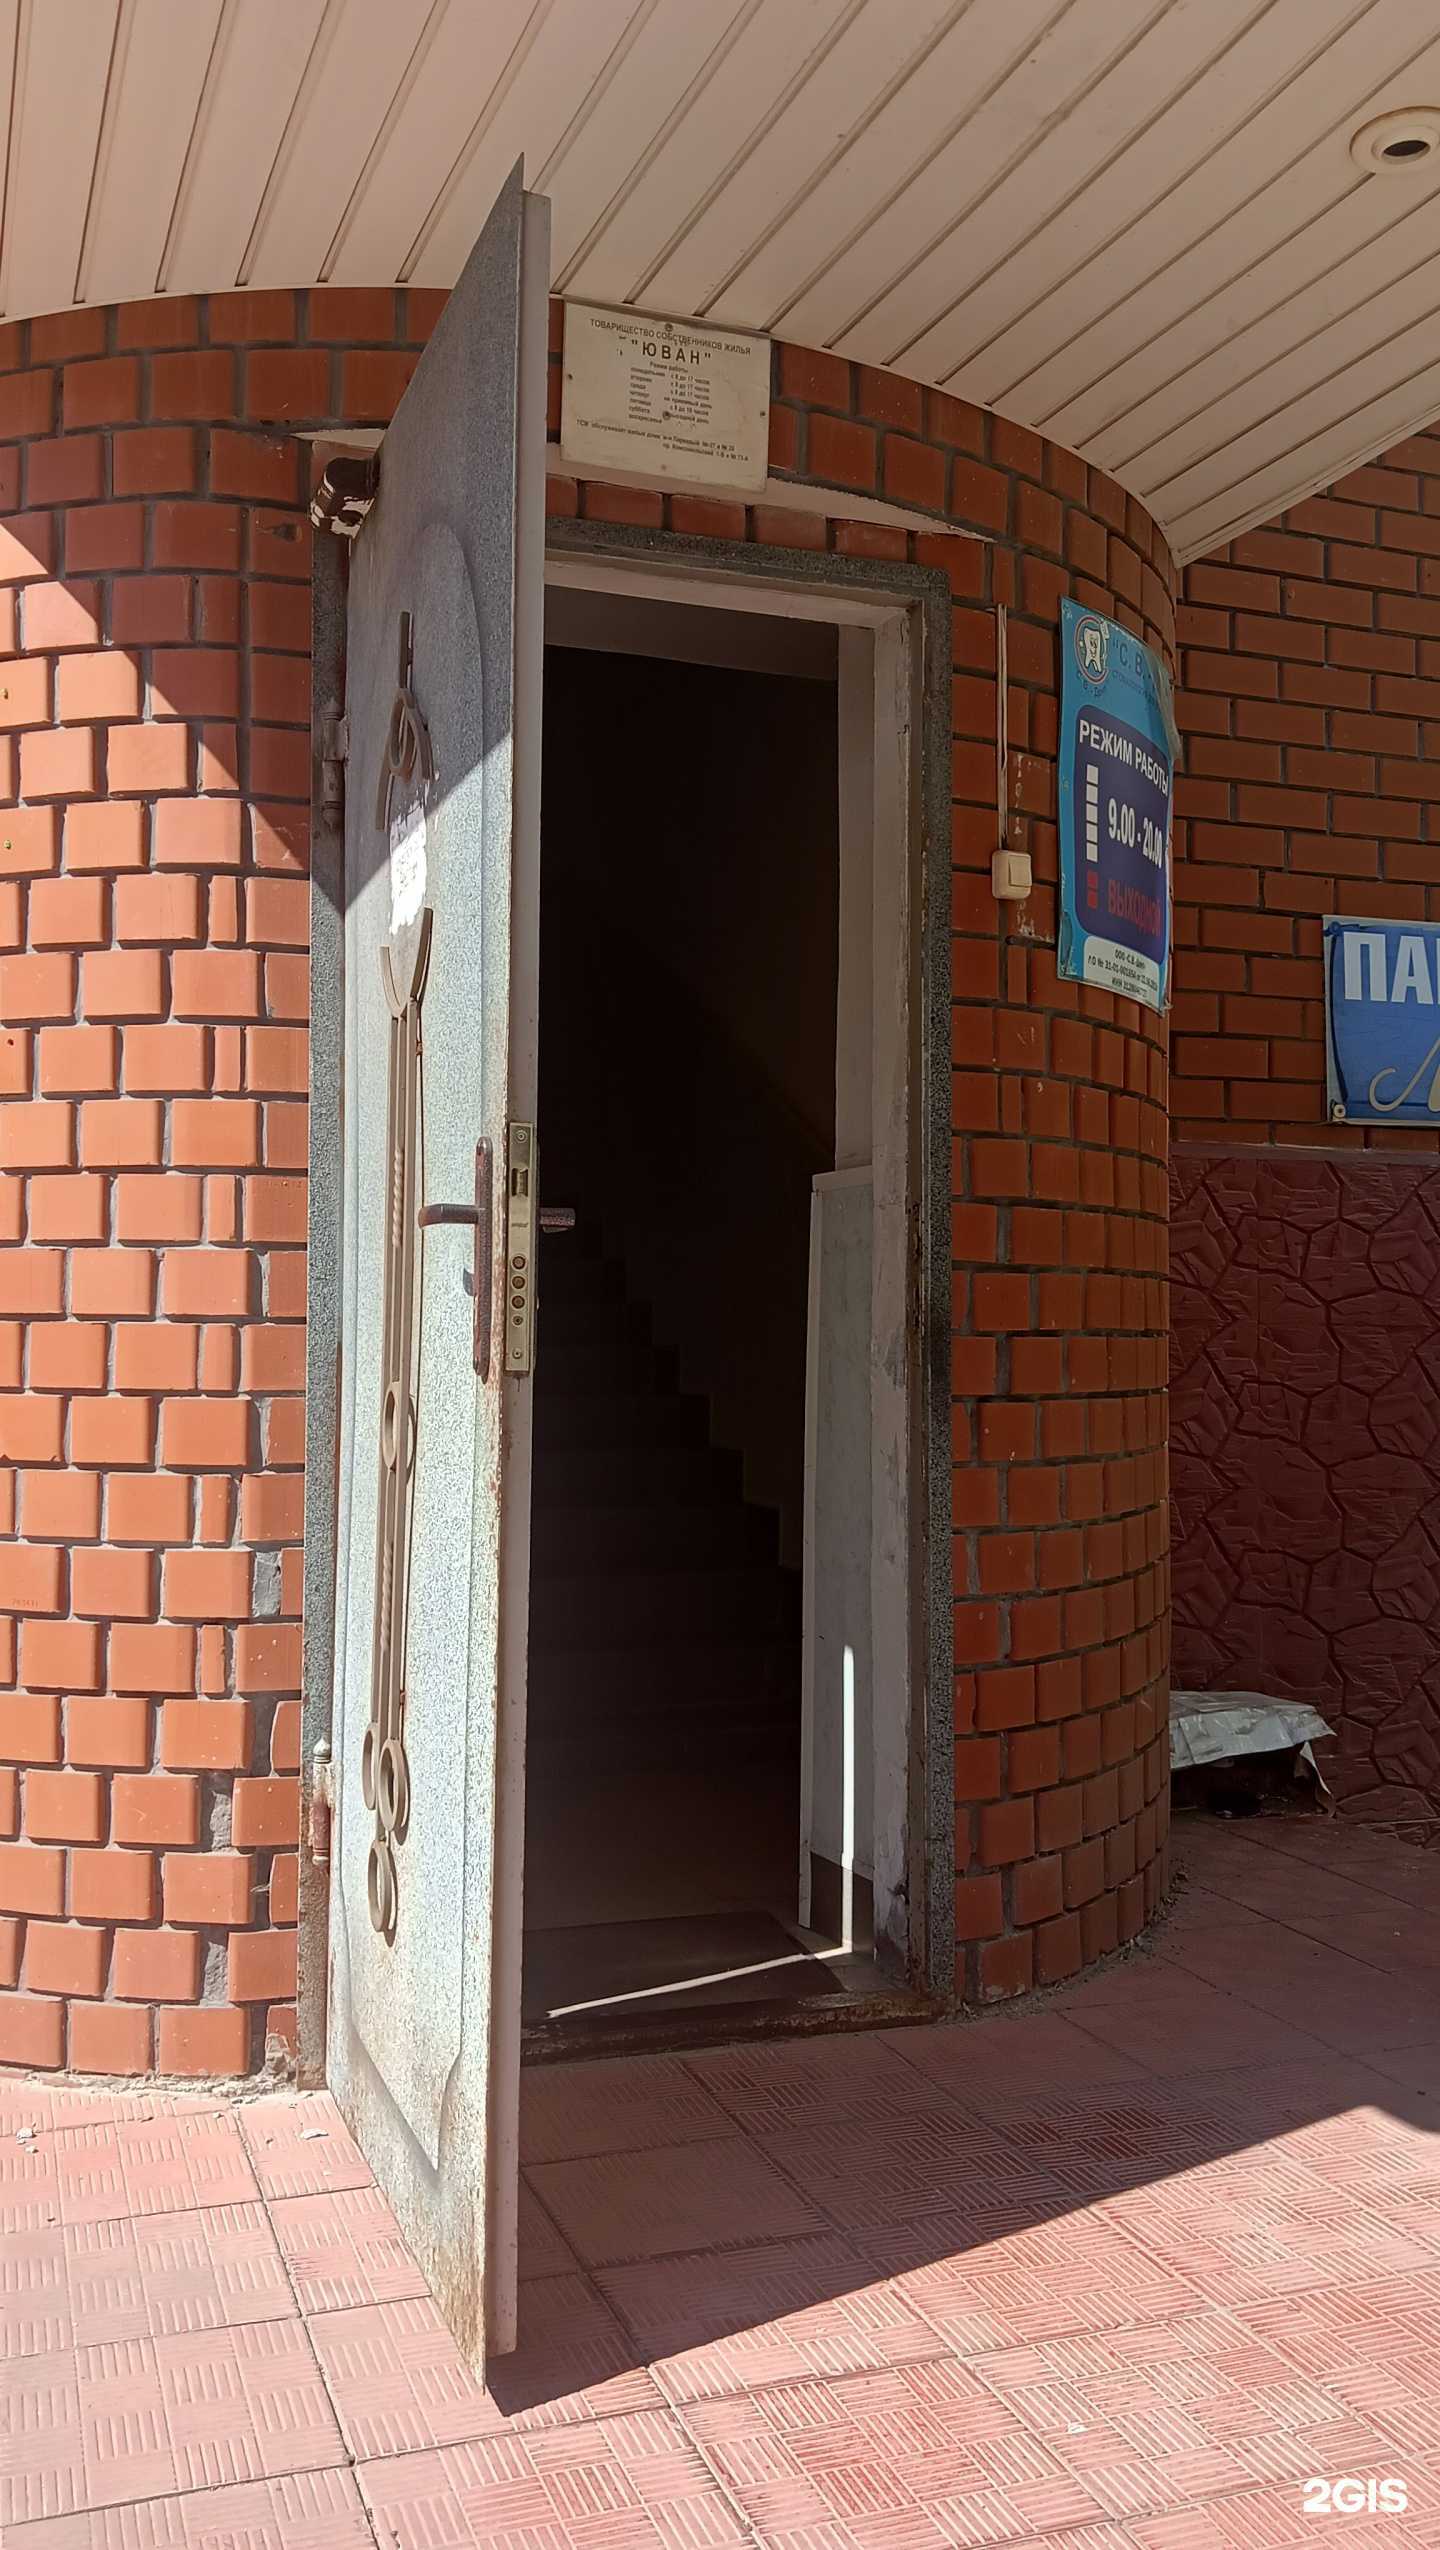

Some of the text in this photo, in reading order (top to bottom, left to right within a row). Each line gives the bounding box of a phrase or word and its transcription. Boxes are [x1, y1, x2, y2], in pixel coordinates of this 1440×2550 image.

[590, 318, 751, 355] ТОВАРИЩЕСТВО СОБСТВЕННИКОВ ЖИЛЬЯ
[1079, 719, 1169, 796] РЕЖИМ РАБОТЫ
[1108, 798, 1135, 848] 9.00
[1142, 816, 1164, 869] 20.00
[1343, 931, 1440, 1005] ПА
